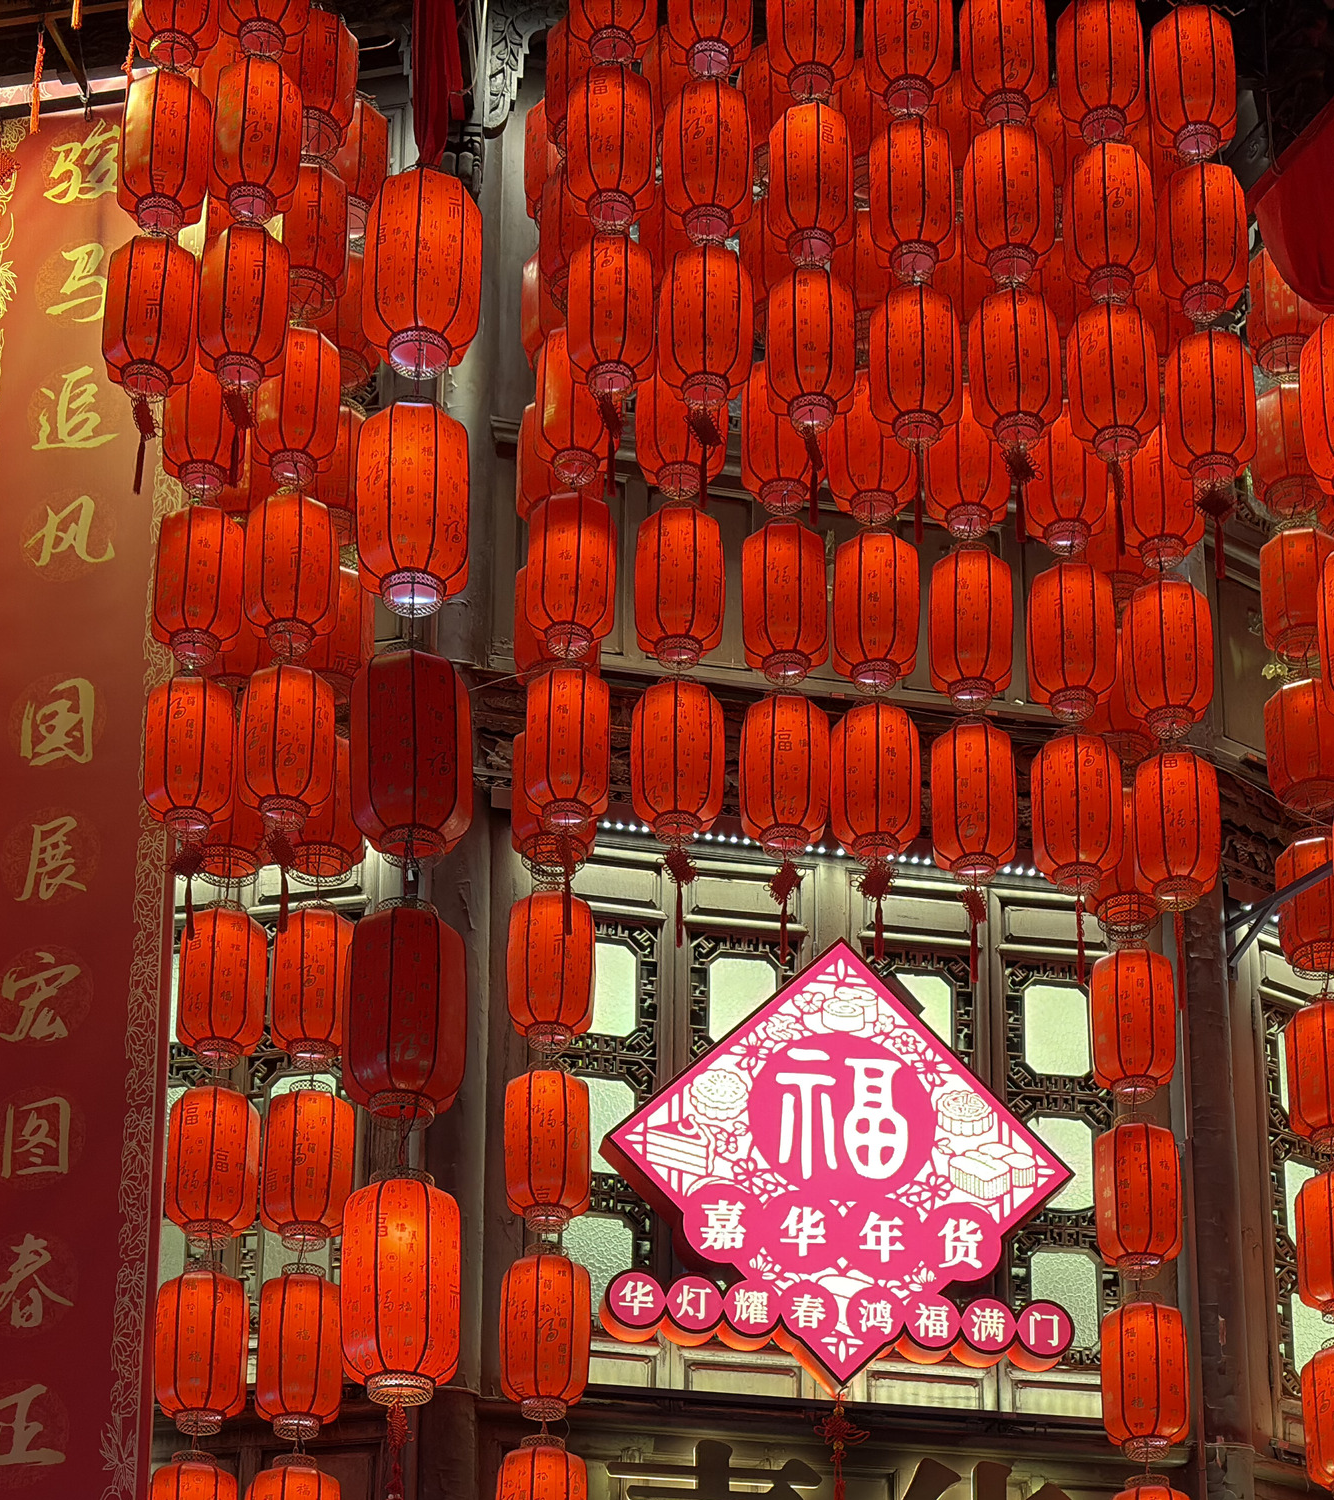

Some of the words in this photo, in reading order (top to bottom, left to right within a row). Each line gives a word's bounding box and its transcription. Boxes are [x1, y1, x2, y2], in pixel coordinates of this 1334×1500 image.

[774, 1046, 908, 1181] 福
[699, 1199, 984, 1271] 嘉华年货
